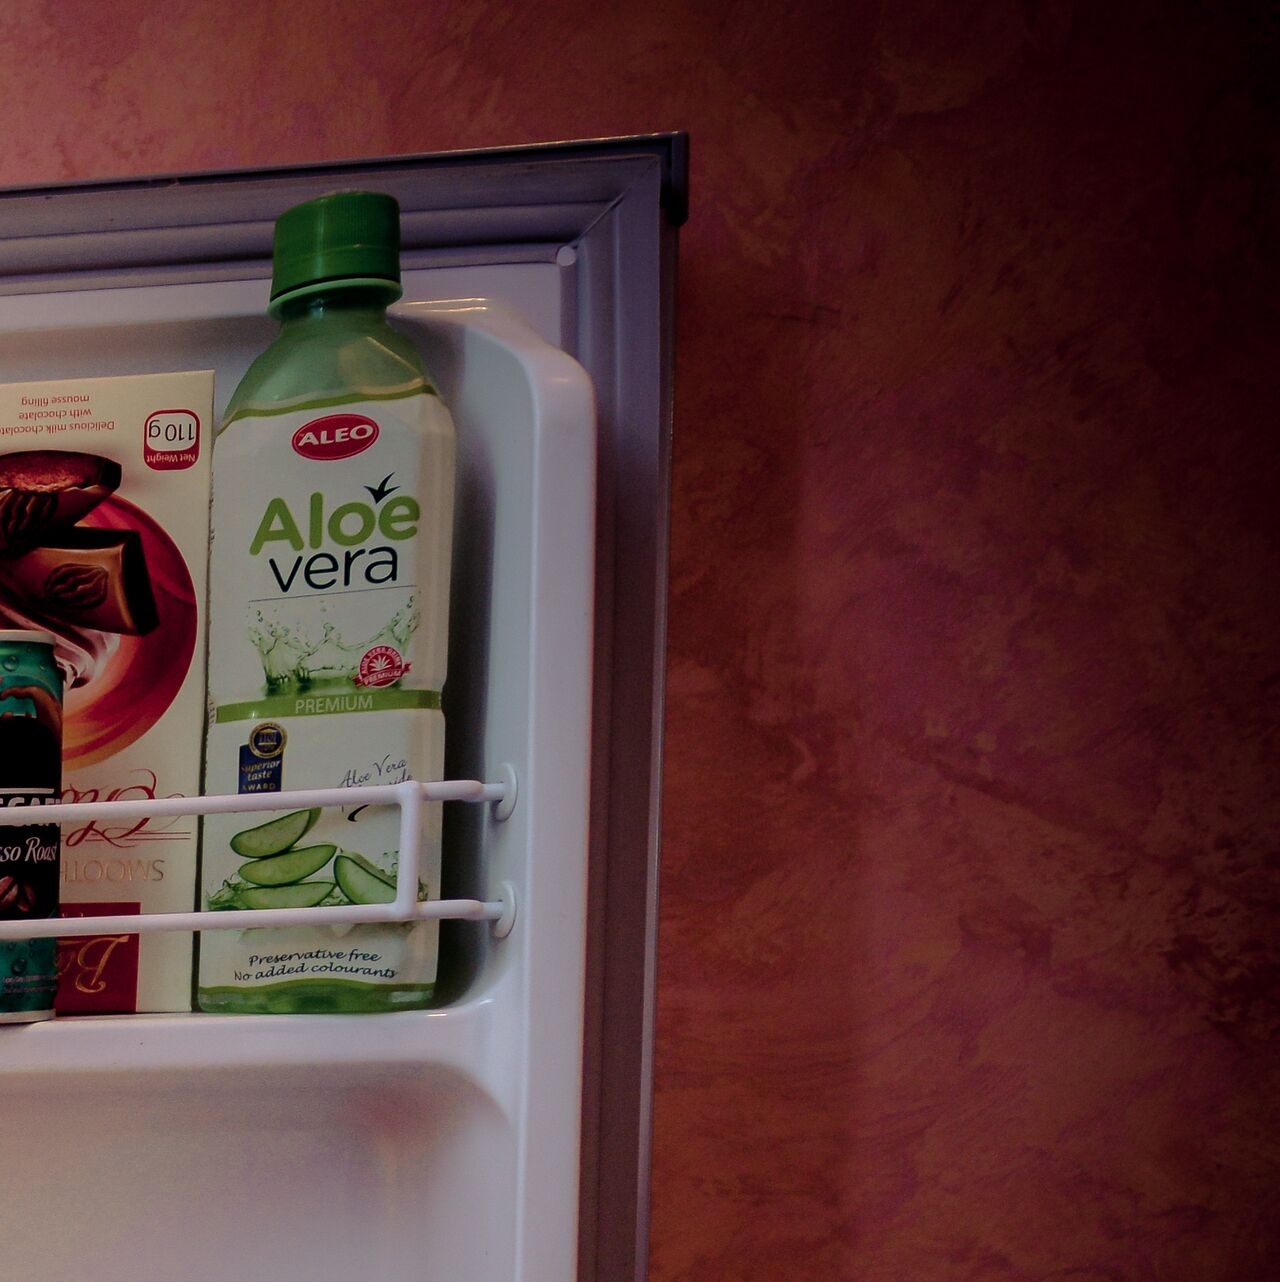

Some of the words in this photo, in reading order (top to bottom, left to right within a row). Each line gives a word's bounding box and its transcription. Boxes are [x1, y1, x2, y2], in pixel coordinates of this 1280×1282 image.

[21, 396, 49, 407] filling
[51, 395, 91, 404] mousse
[18, 410, 67, 421] chocolate
[67, 408, 92, 418] with
[46, 423, 68, 433] milk
[69, 420, 116, 432] Delicious
[148, 419, 162, 439] g
[165, 423, 195, 441] 110
[298, 423, 374, 448] ALEO
[146, 454, 177, 465] Weight
[178, 453, 196, 462] Net
[248, 491, 421, 556] Aloe
[268, 546, 398, 593] vera
[295, 695, 374, 714] PREMIUM
[247, 770, 273, 782] taste
[339, 769, 372, 788] Aloe
[372, 754, 407, 776] Vera
[242, 782, 277, 791] AWARD
[24, 836, 58, 864] Roast
[249, 949, 348, 967] Preservative
[348, 948, 382, 962] free
[234, 970, 253, 981] No
[255, 963, 309, 980] added
[310, 962, 398, 979] colourants
